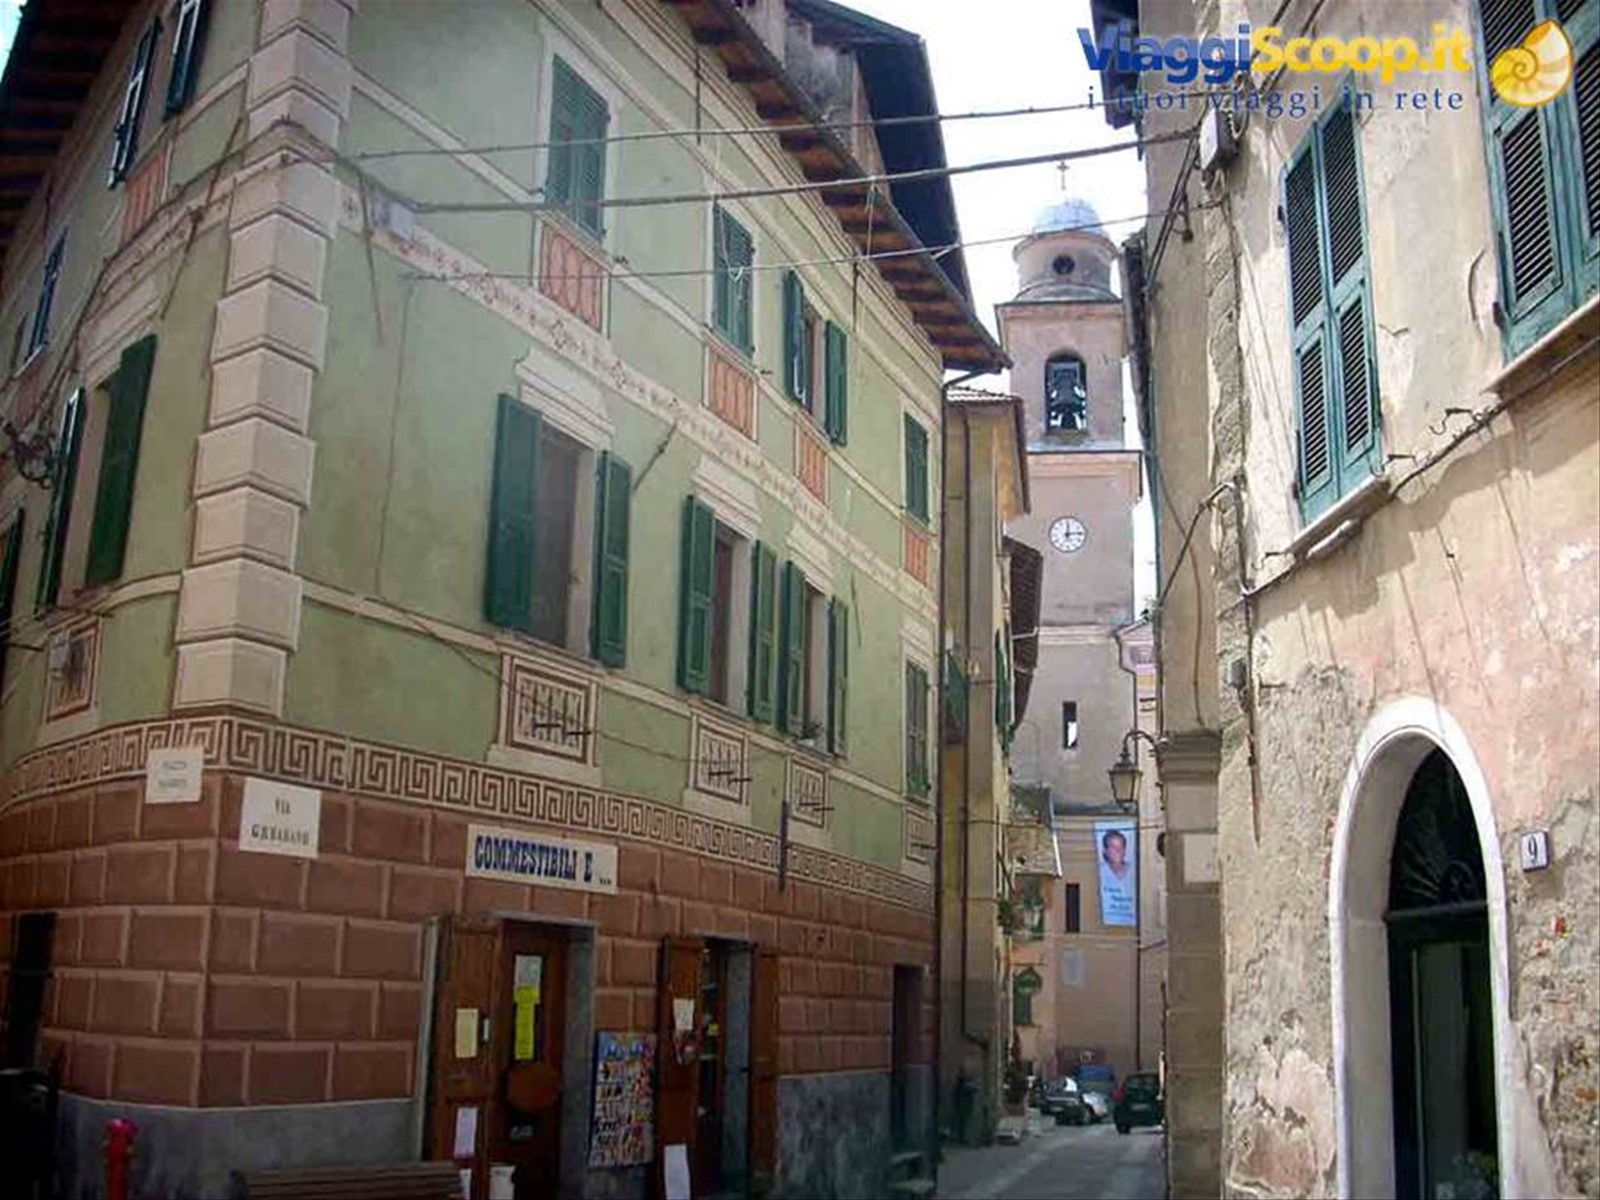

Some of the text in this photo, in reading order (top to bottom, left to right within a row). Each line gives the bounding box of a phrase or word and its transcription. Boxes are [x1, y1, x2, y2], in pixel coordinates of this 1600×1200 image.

[275, 797, 291, 815] VIA
[474, 834, 577, 881] COMMESTIBILI
[1528, 835, 1538, 864] 9
